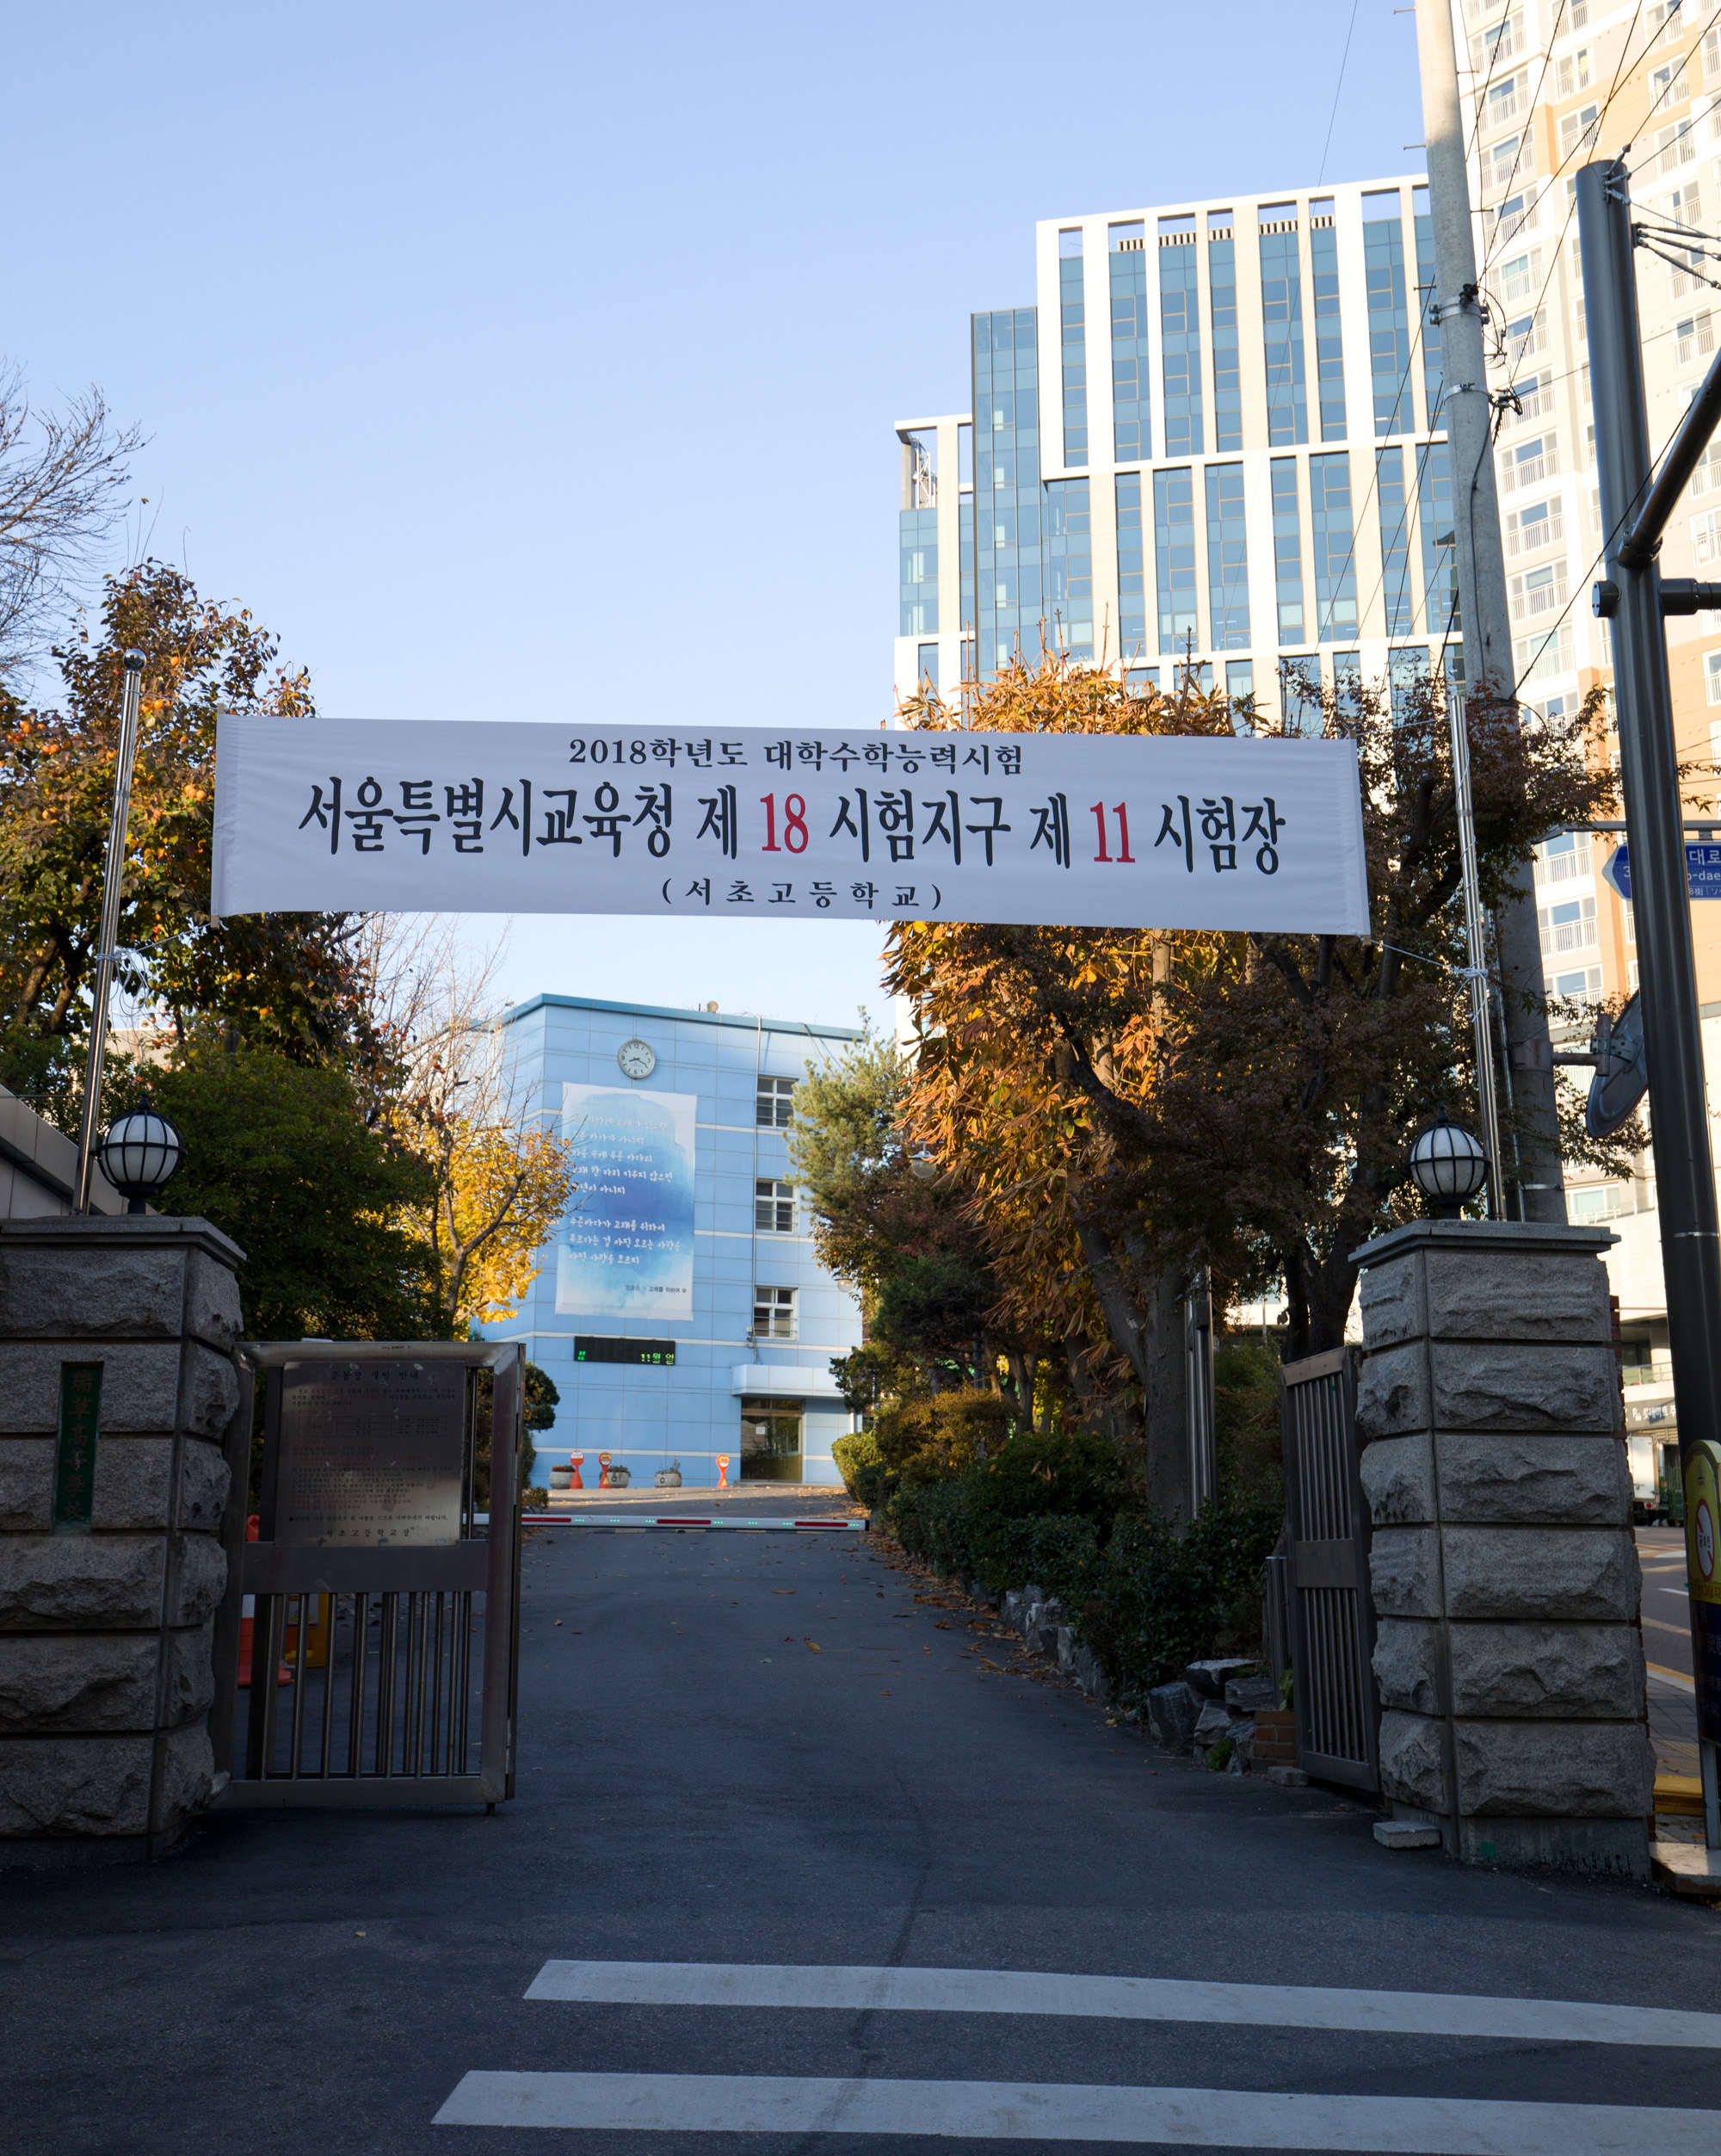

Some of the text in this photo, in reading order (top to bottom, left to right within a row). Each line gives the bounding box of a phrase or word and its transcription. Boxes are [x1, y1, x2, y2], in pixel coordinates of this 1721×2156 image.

[569, 738, 1022, 776] 2018학년도 대학수학능력시험
[298, 775, 1286, 875] 서울특별시교육청 제 18 시험지구 제 11 시험장
[610, 1150, 624, 1162] 푸른
[591, 1165, 601, 1177] 한
[603, 1168, 620, 1177] 마리
[624, 1169, 646, 1179] 키우지
[649, 1170, 673, 1183] 않으면
[599, 1184, 626, 1195] 아니지
[614, 1219, 637, 1232] 고래를
[639, 1220, 666, 1232] 위하여
[570, 1233, 600, 1246] 푸르다는
[602, 1235, 611, 1248] 걸
[614, 1236, 632, 1249] 아직
[633, 1238, 655, 1251] 모르는
[617, 1254, 640, 1265] 모르지
